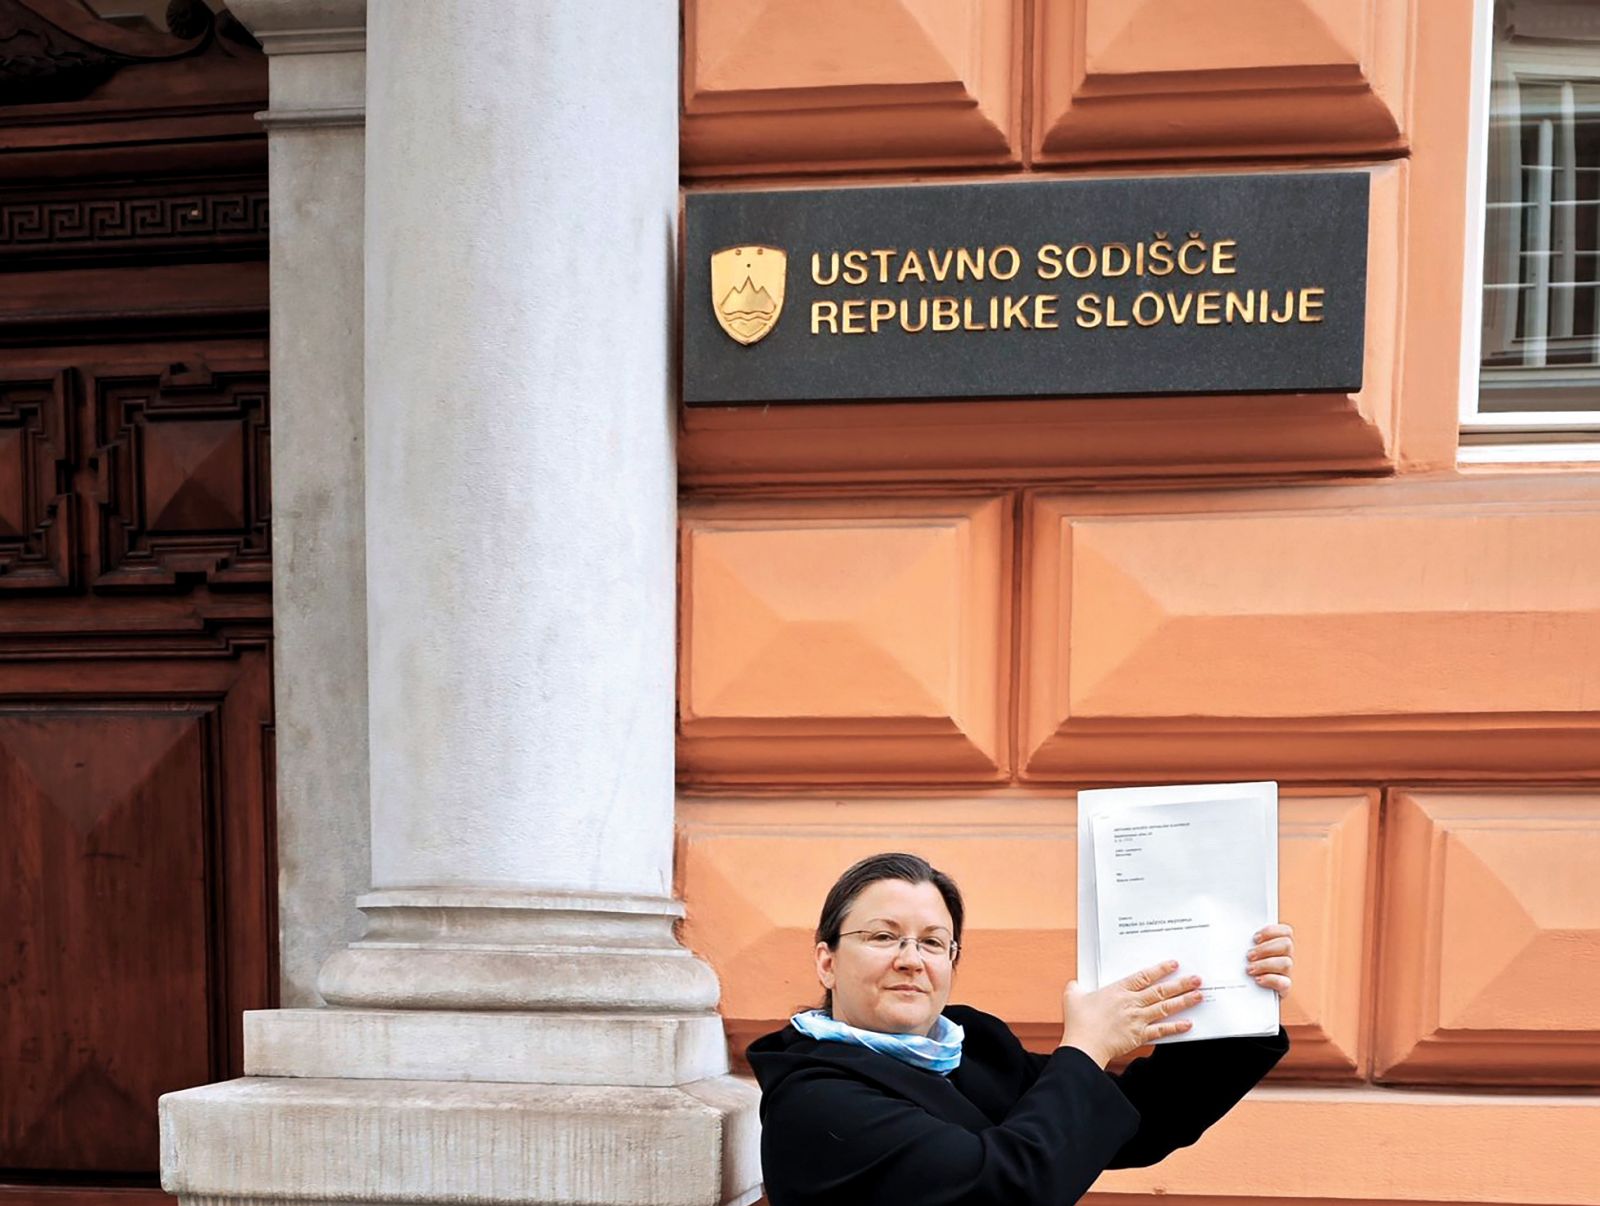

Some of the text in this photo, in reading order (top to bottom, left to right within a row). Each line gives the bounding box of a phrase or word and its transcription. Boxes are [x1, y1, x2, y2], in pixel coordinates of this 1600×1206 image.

[810, 231, 1238, 286] USTAVNO SODIŠČE
[810, 286, 1326, 335] REPUBLIKE SLOVENIJE
